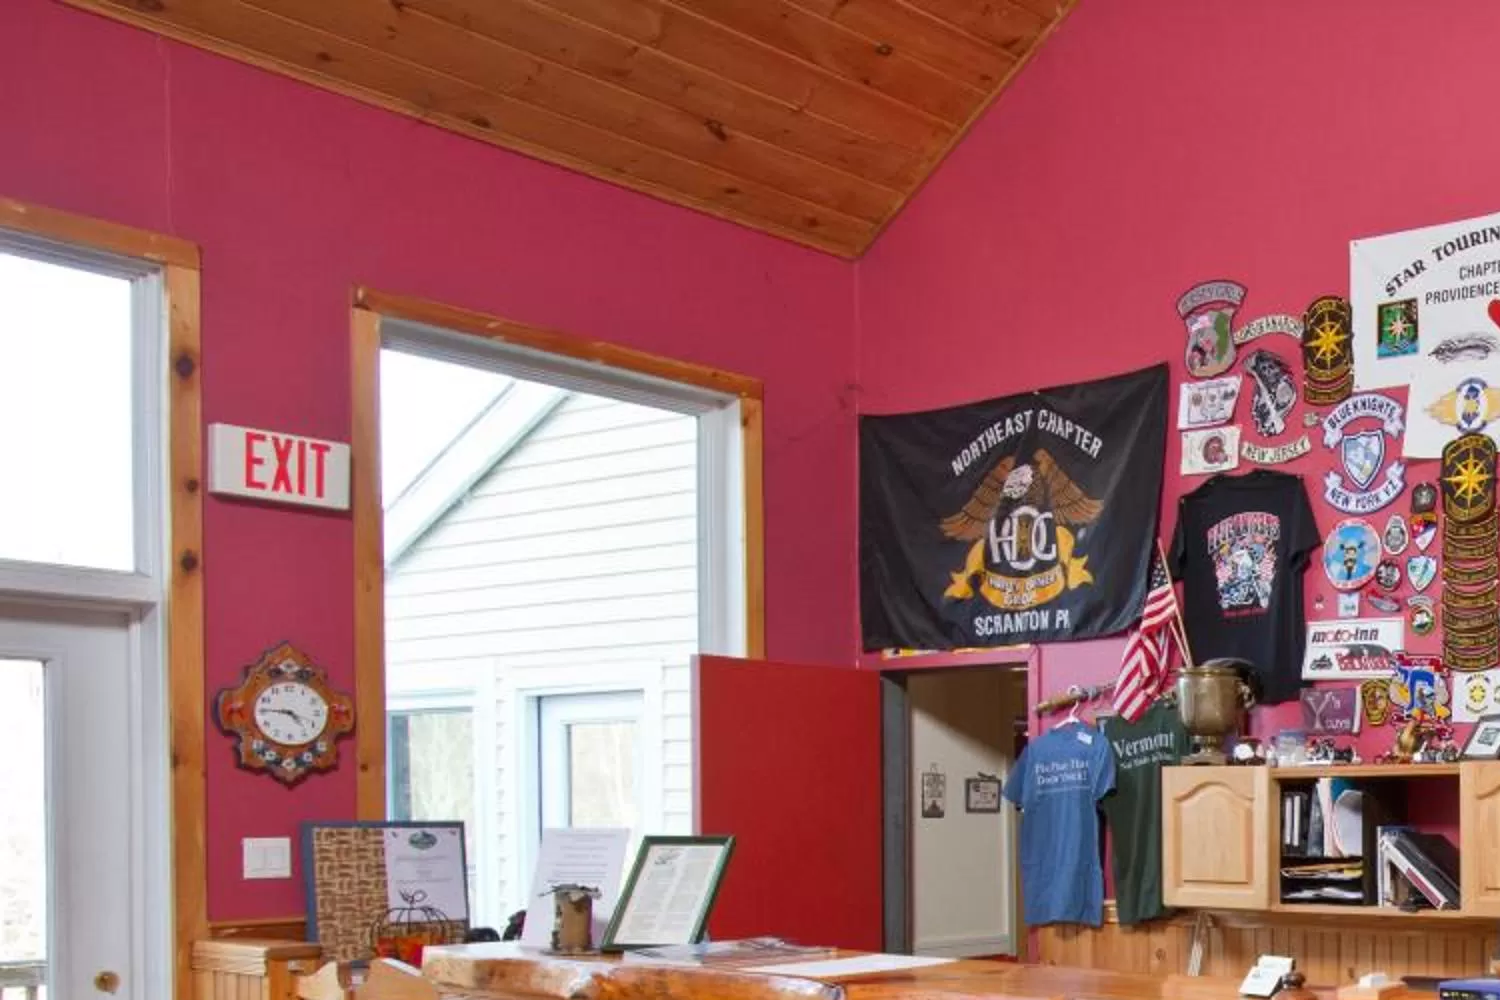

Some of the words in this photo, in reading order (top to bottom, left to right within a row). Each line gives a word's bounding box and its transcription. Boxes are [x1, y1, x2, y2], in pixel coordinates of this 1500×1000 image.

[1385, 259, 1427, 297] STAR
[1425, 283, 1500, 305] PROVIDENCE
[1328, 403, 1352, 429] BLUE
[1352, 398, 1396, 422] KNIGHTS
[952, 409, 1033, 476] NORTHEAST
[1037, 409, 1103, 460] CHAPTER
[244, 431, 331, 499] EXIT
[974, 610, 1050, 636] SCRANTON
[1055, 609, 1070, 627] PA
[1113, 733, 1175, 759] Vermont
